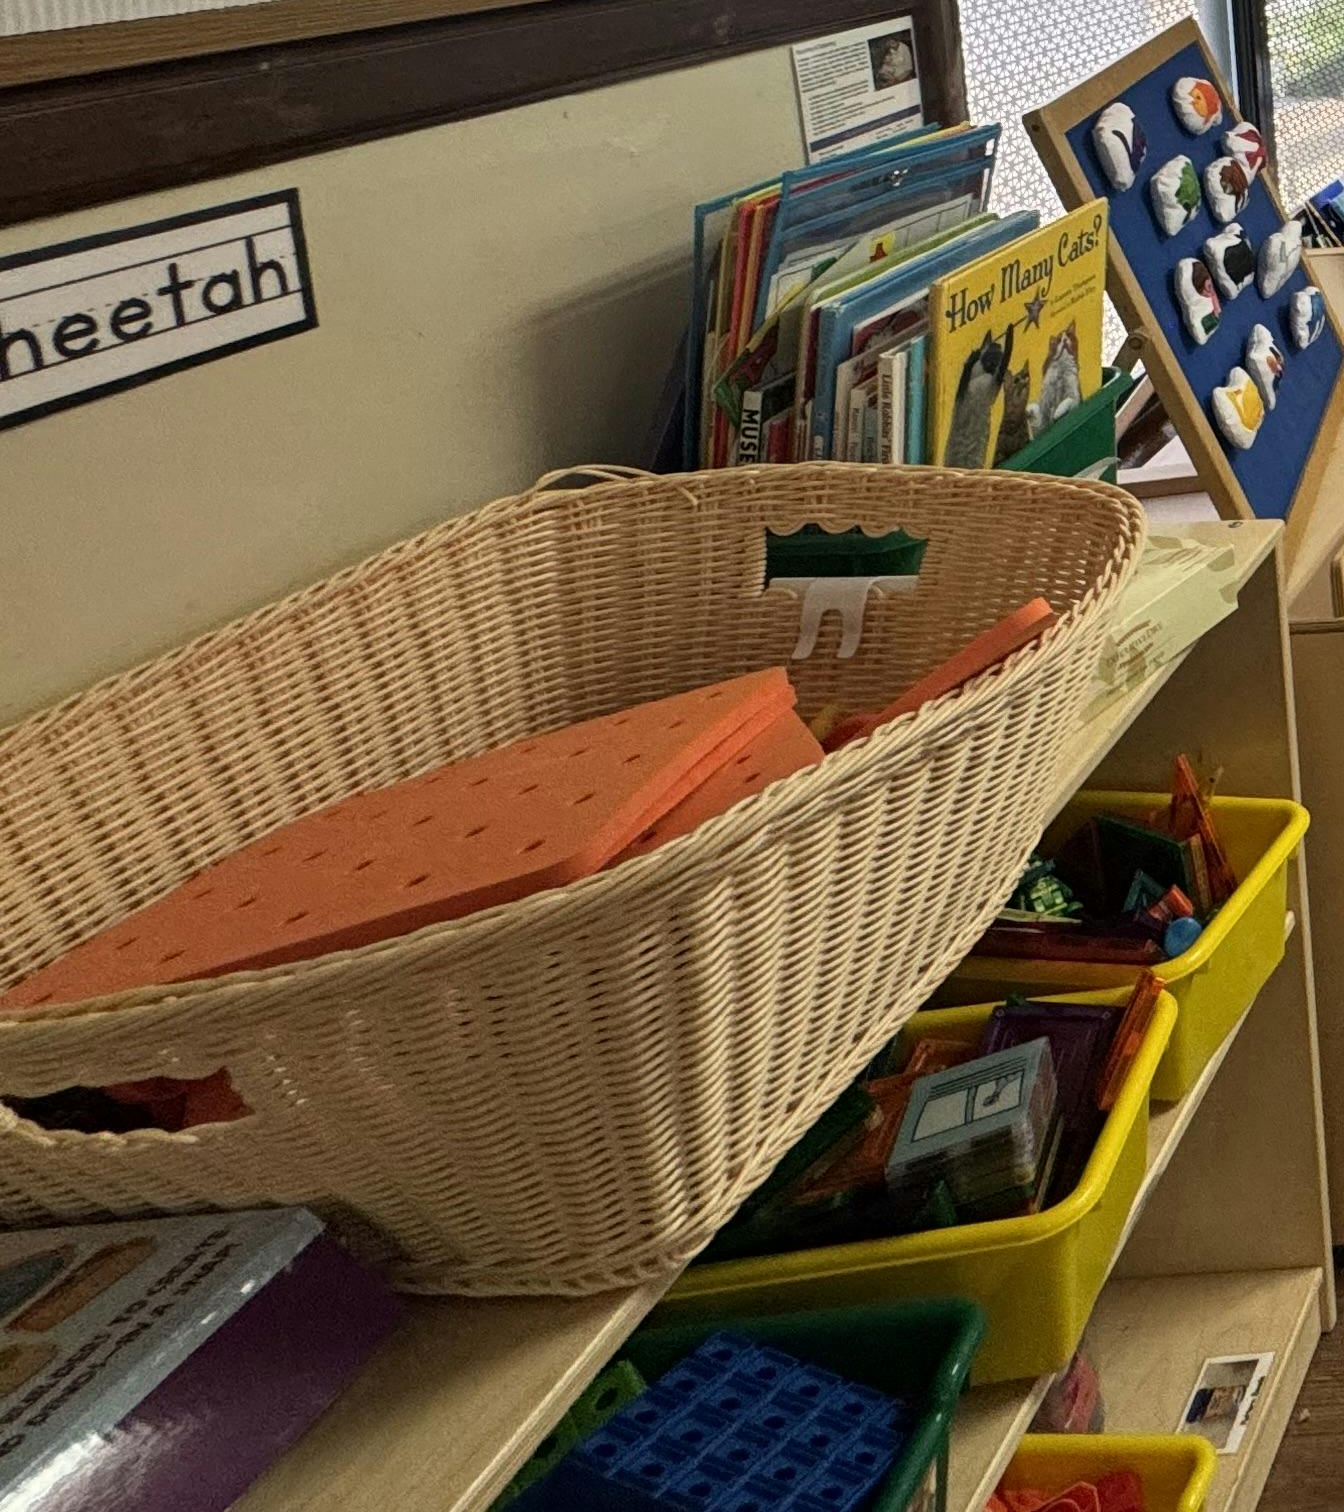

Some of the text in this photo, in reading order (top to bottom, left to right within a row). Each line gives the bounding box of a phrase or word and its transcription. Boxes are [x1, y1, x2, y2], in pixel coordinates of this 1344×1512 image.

[945, 282, 995, 334] How
[999, 257, 1053, 303] Many
[1057, 214, 1102, 267] Cats?
